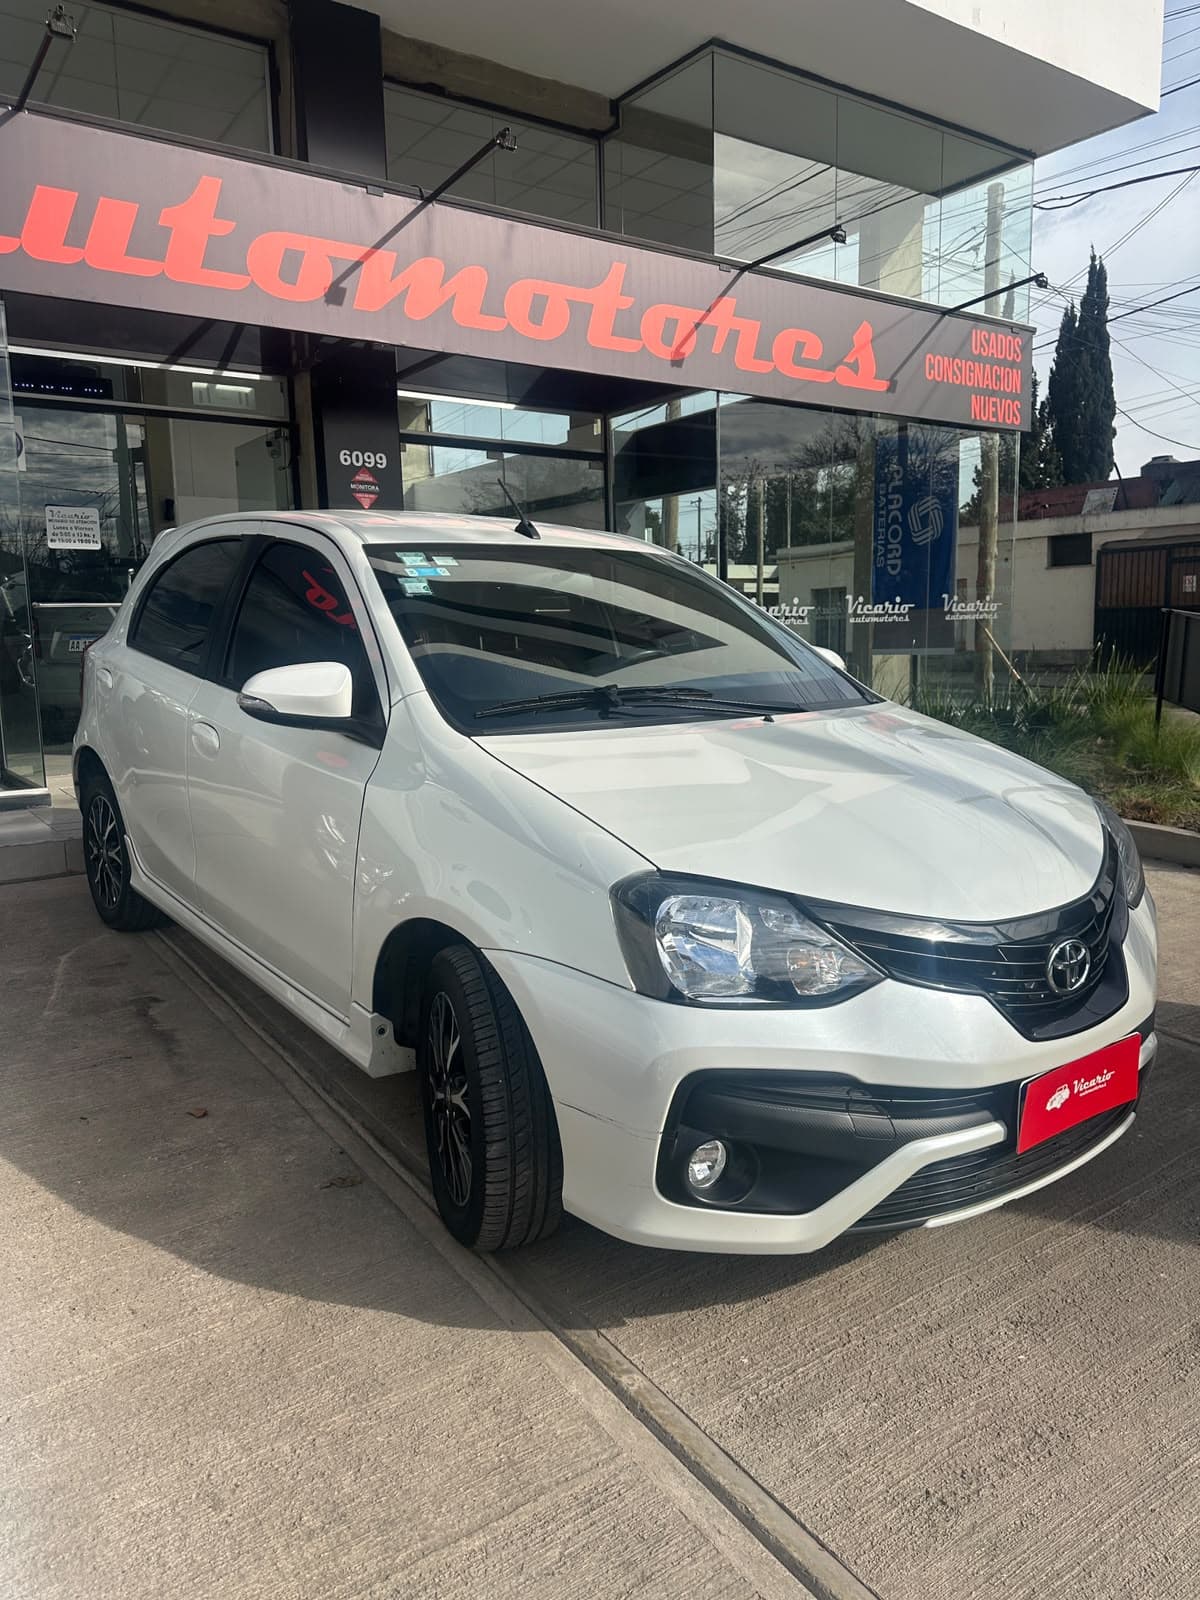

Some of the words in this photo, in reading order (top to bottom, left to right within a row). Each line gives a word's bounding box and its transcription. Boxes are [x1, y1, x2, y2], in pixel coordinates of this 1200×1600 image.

[0, 175, 889, 391] utomotores
[972, 328, 1022, 362] USADOS
[925, 353, 1021, 393] CONSIGNACION
[971, 395, 1021, 425] NUEVOS
[340, 449, 387, 469] 6099
[844, 594, 916, 614] Vicario
[941, 593, 1004, 612] Vicario
[849, 614, 911, 623] automotores
[1073, 1069, 1116, 1095] Vicario
